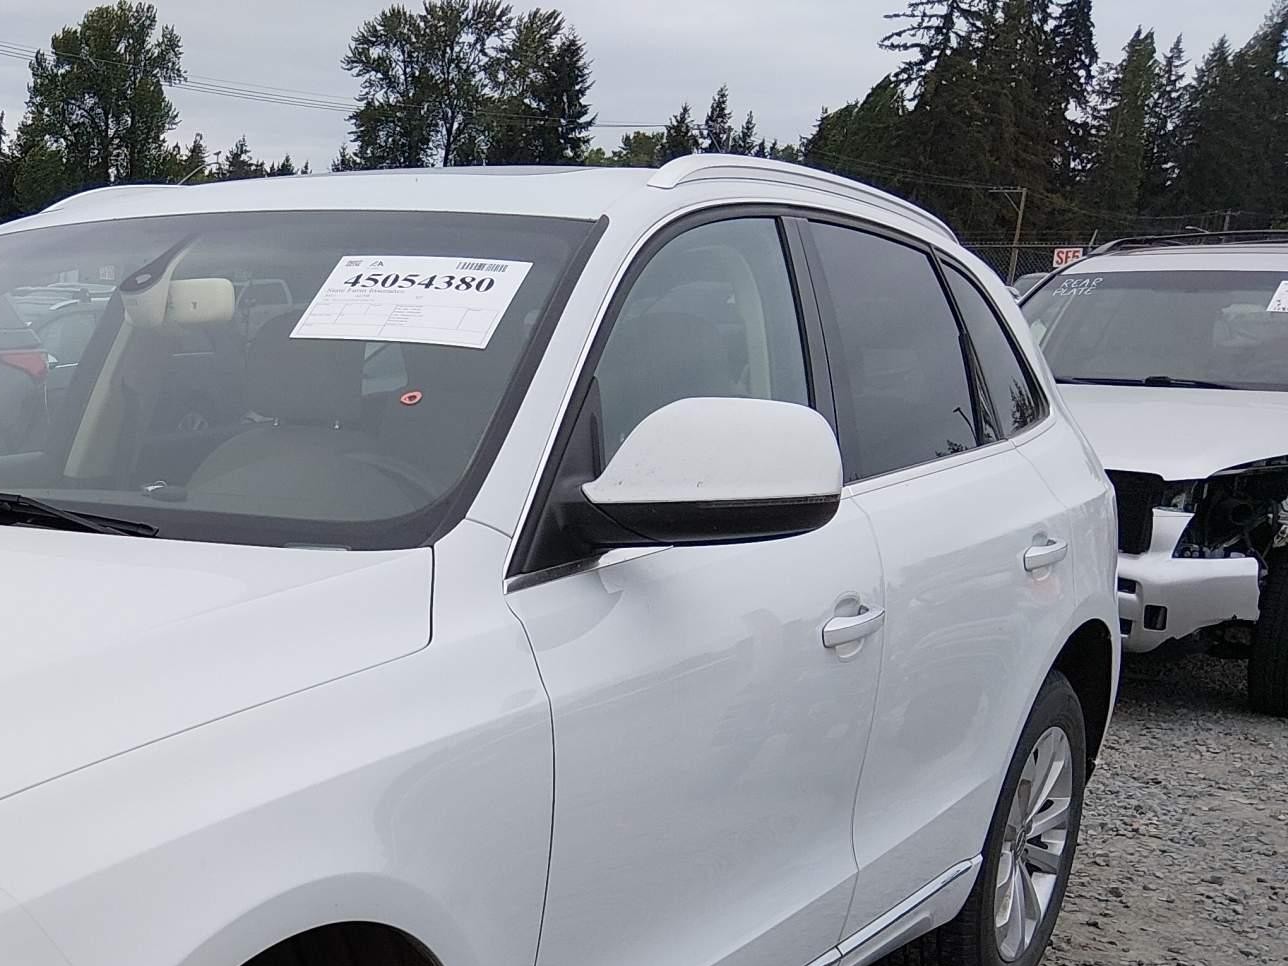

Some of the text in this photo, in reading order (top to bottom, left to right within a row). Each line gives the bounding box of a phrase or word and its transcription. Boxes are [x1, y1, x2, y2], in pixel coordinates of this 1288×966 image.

[344, 273, 495, 292] 45054380
[1060, 277, 1103, 289] REAR
[1052, 287, 1097, 296] PLATE
